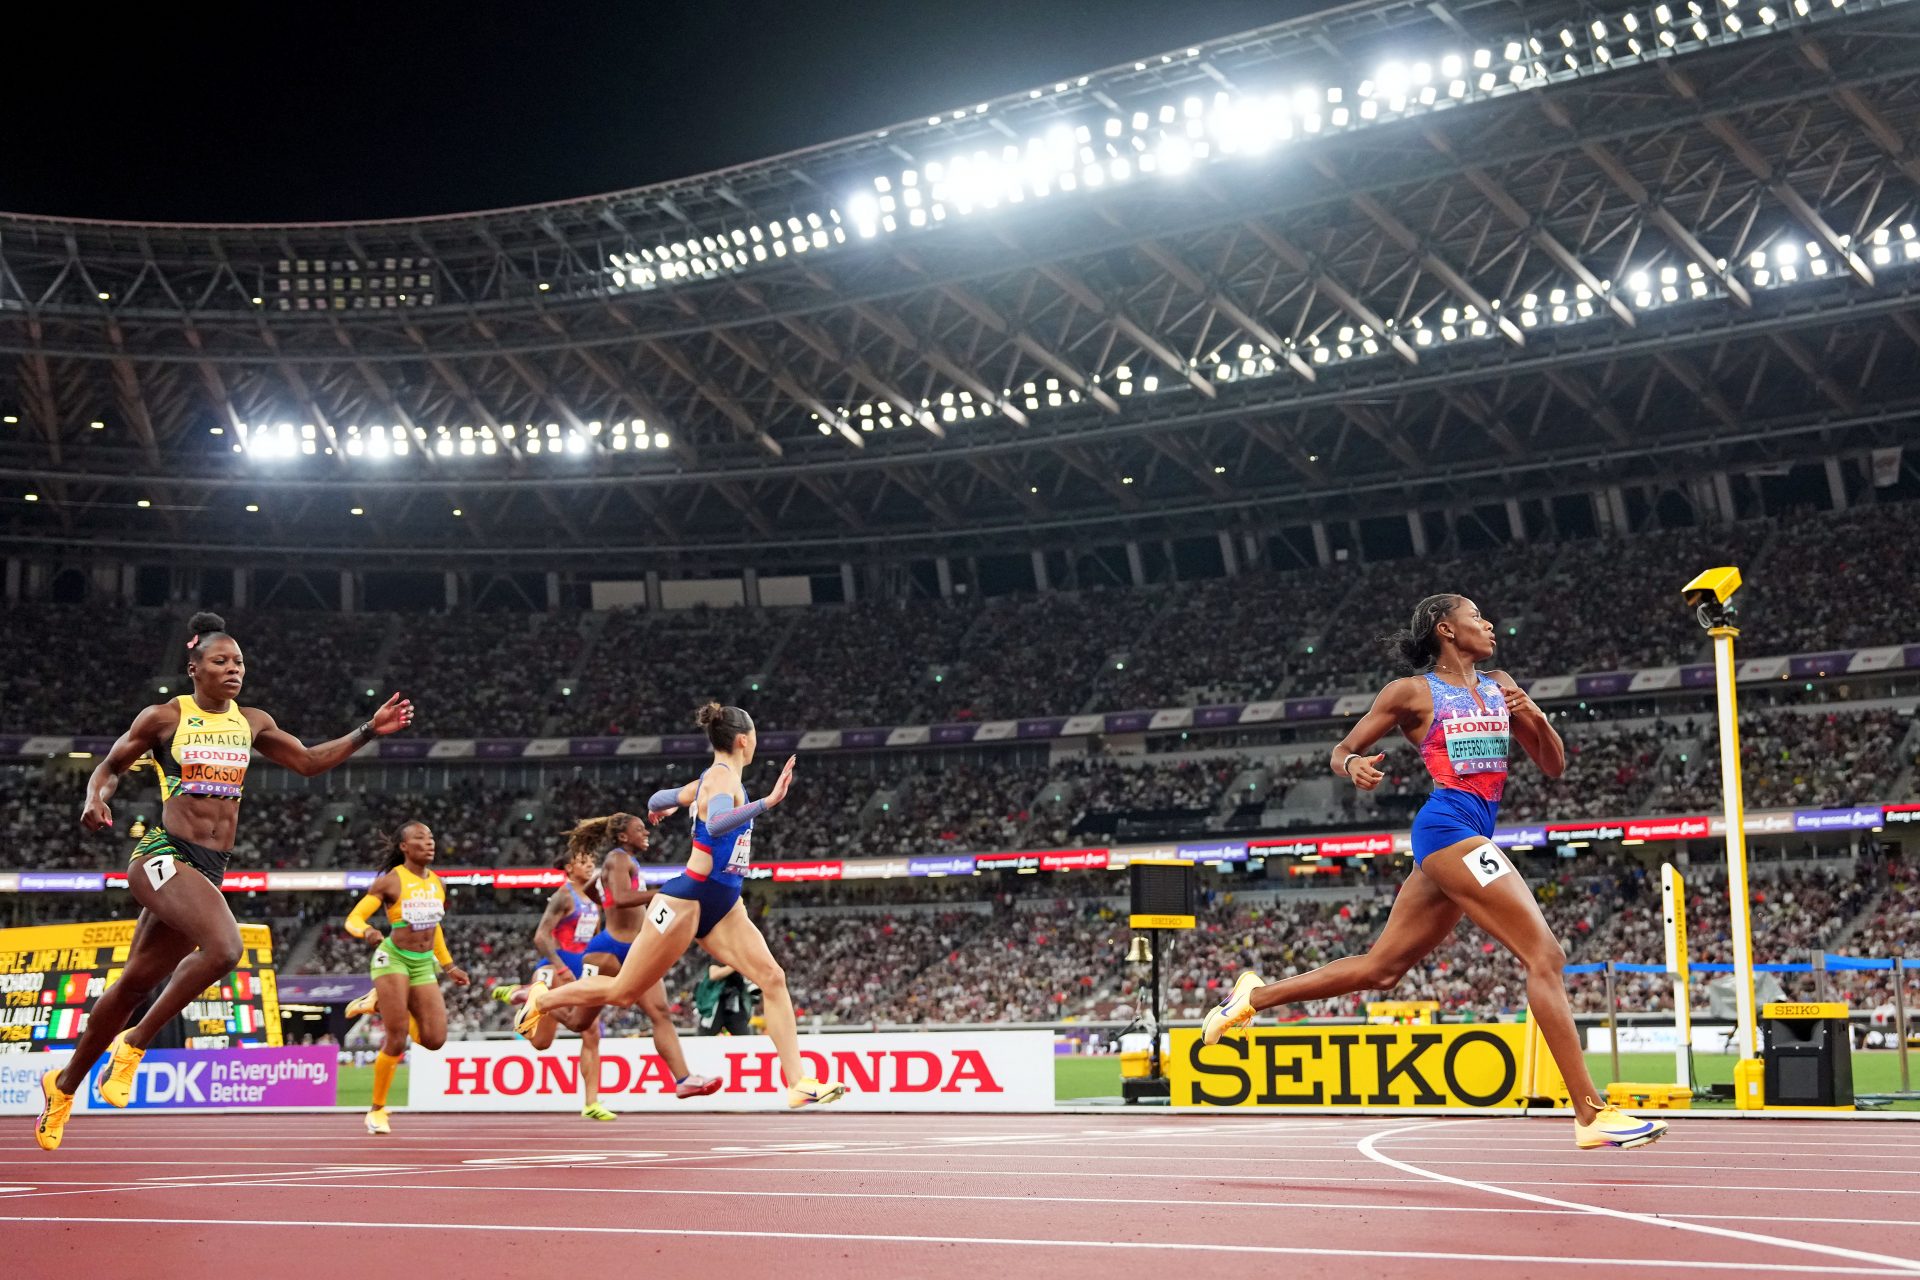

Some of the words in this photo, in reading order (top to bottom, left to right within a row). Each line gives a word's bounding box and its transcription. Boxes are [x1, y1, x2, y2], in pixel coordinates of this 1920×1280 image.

[1446, 721, 1509, 735] HONDA
[184, 733, 248, 747] JAMAICA
[184, 750, 248, 763] HONDA
[149, 860, 165, 881] 7
[1479, 851, 1500, 875] 6
[655, 908, 668, 925] 5
[1774, 1005, 1820, 1016] SEIKO
[212, 1060, 228, 1081] In
[230, 1058, 329, 1086] Everything,
[444, 1055, 678, 1096] HONDA
[724, 1050, 1004, 1093] HONDA
[1190, 1030, 1517, 1107] SEIKO
[134, 1061, 209, 1104] TDK
[210, 1082, 267, 1102] Better
